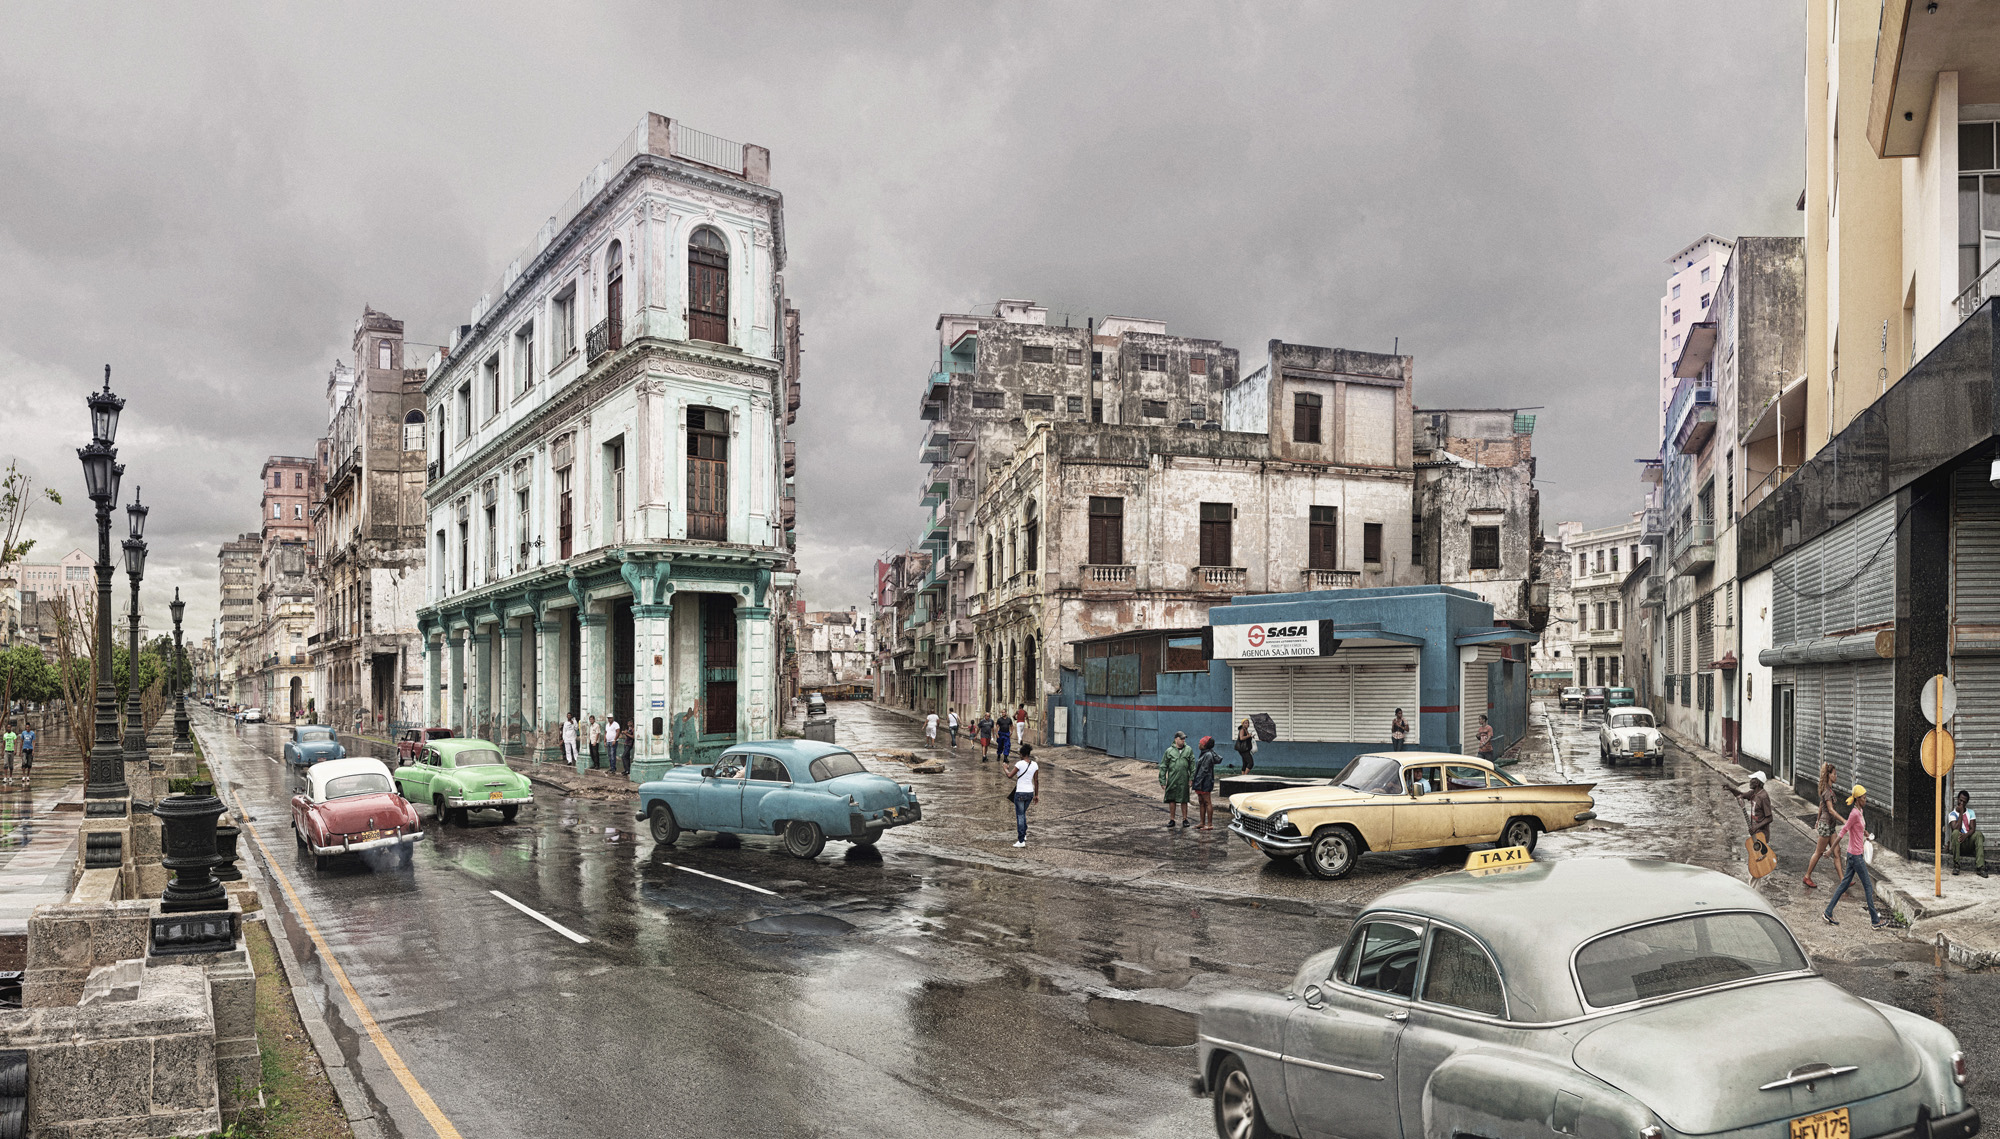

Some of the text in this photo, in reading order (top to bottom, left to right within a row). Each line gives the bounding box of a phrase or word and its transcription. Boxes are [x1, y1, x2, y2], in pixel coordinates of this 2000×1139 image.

[1267, 626, 1307, 637] SASA
[1242, 649, 1270, 657] AGENCIA
[1291, 647, 1315, 656] MOTOS
[1481, 850, 1521, 863] TAXI
